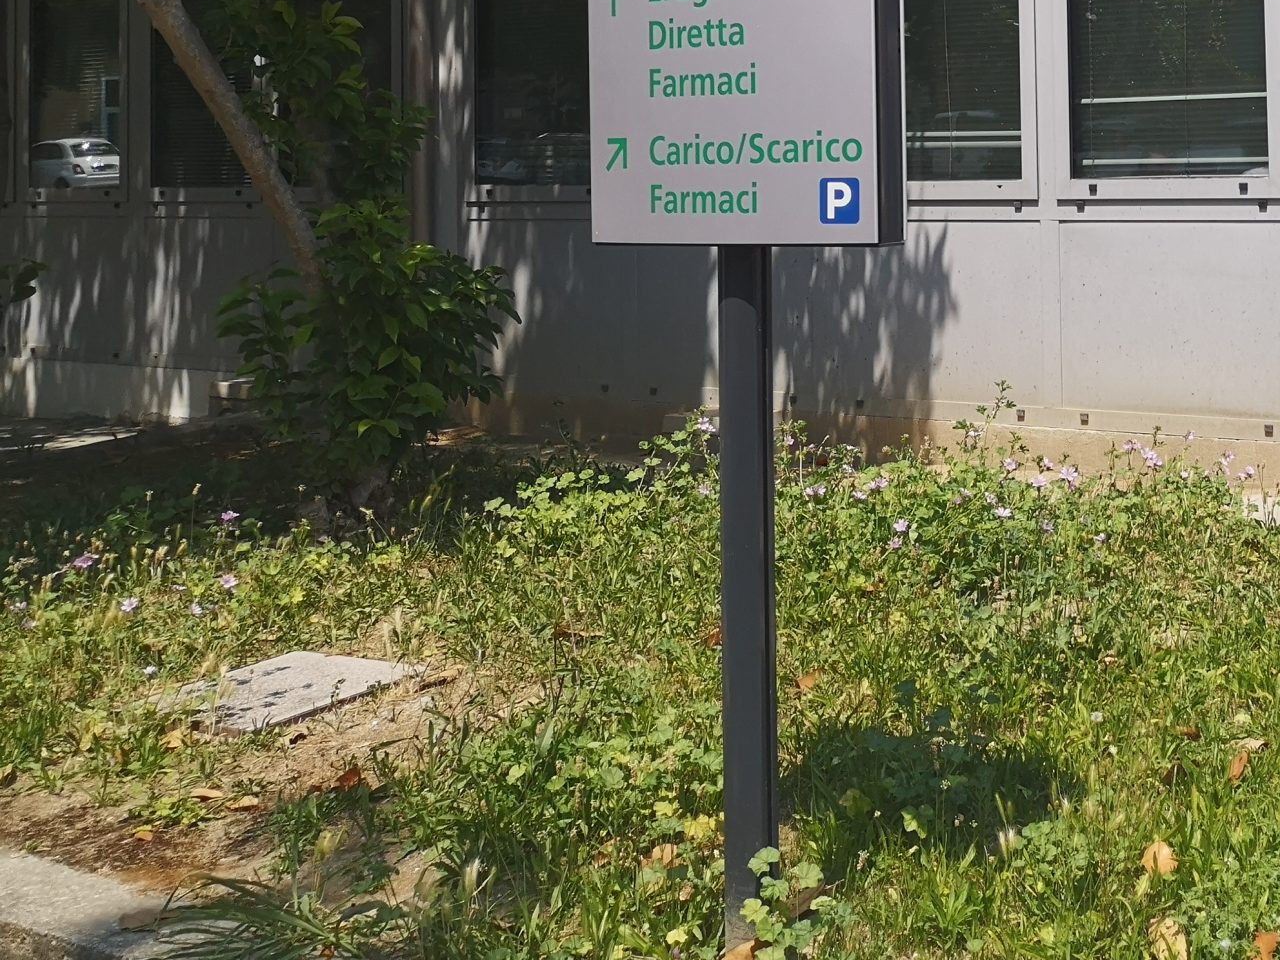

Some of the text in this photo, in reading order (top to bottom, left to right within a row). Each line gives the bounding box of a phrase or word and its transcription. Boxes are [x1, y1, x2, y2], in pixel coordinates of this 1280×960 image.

[648, 17, 745, 50] Diretta
[648, 62, 757, 98] Farmaci
[648, 130, 863, 167] Carico/Scarico
[649, 181, 758, 215] Farmaci
[826, 181, 852, 220] P
